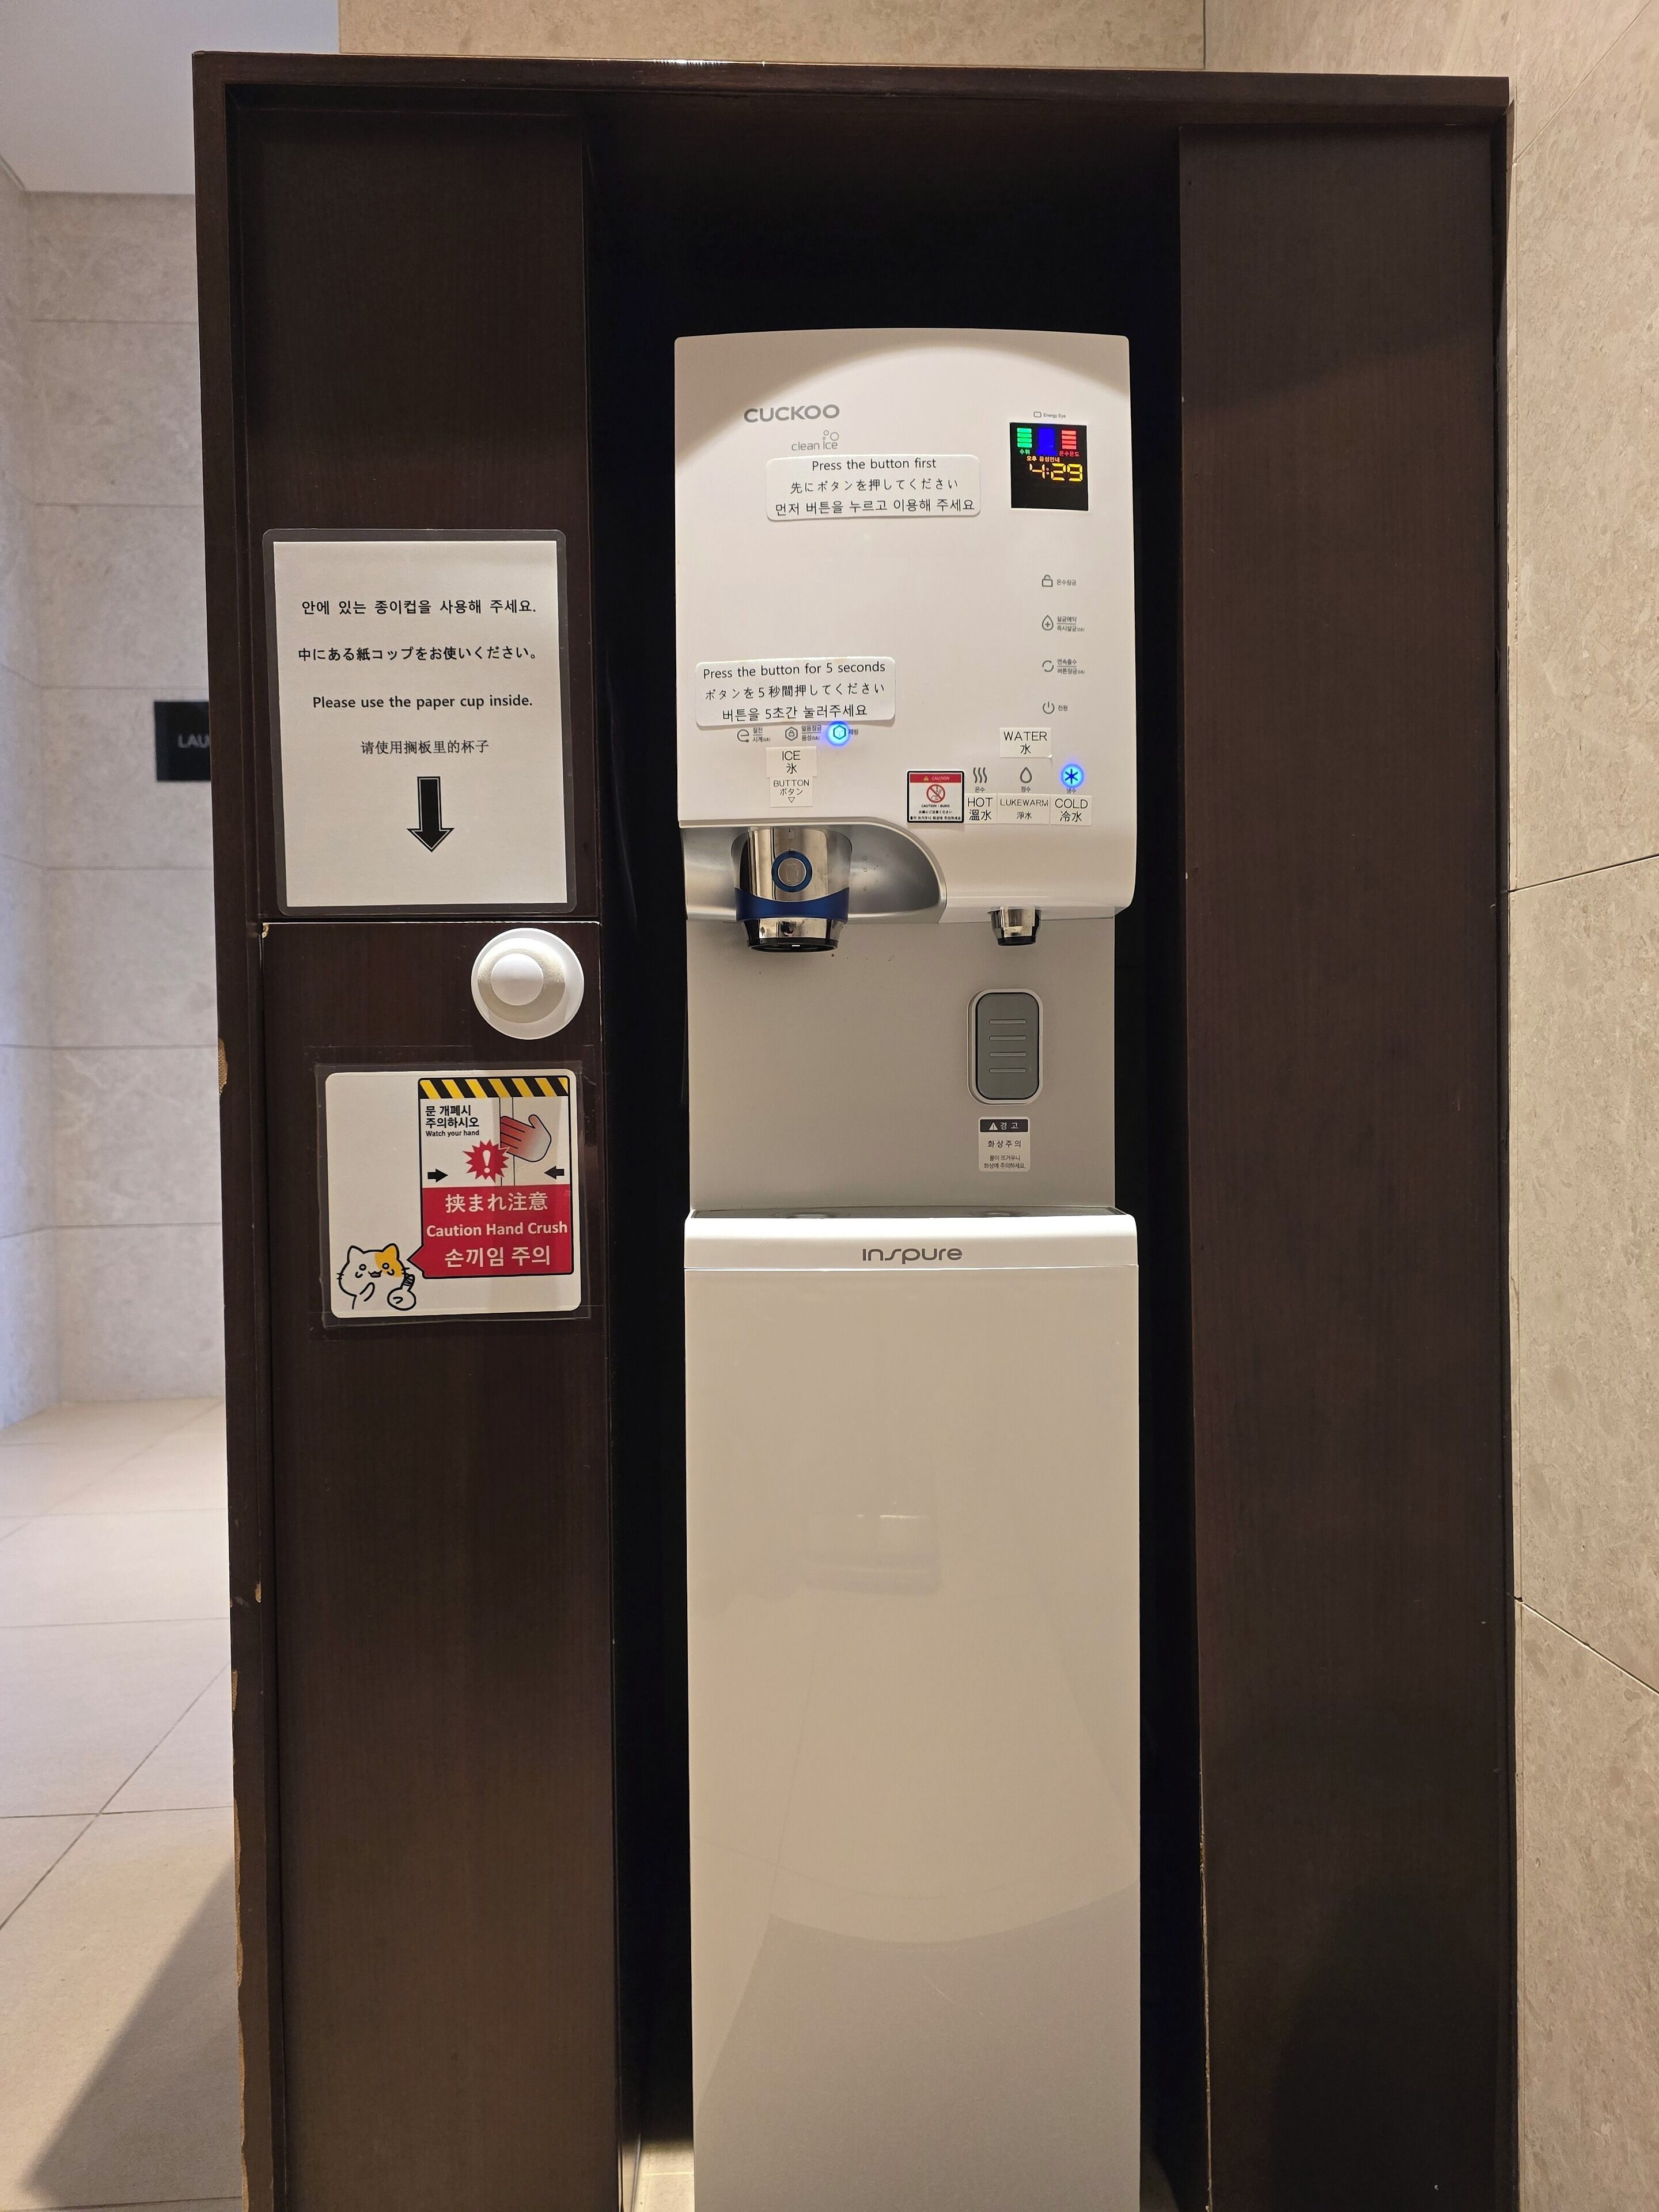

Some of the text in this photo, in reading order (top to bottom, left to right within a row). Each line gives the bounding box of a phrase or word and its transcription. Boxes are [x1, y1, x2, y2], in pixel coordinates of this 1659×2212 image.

[744, 404, 840, 423] CUCKOO
[791, 441, 820, 451] clean
[812, 457, 936, 471] Press the button first
[1029, 463, 1083, 482] 4:29
[790, 478, 958, 494] 先にボタンを押してください
[776, 499, 975, 516] 먼저 버튼을 누르고 이용해 주세요
[302, 599, 536, 615] 안에 있는 종이컵을 사용해 주세요.
[298, 646, 537, 661] 中にある紙コップをお使いください。
[703, 661, 885, 679] Press the button for 5 seconds
[706, 683, 885, 700] ボタンを5秒間押してください
[313, 695, 533, 710] Please use the paper cup inside.
[723, 704, 867, 722] 버튼을 5초간 눌러주세요
[1003, 732, 1047, 741] WATER
[361, 740, 489, 755] 请使用搁板里的杯子
[1020, 744, 1031, 755] 水
[782, 751, 801, 761] ICE
[786, 763, 797, 774] 氷
[968, 797, 993, 807] HOT
[1055, 798, 1088, 809] COLD
[1060, 811, 1082, 822] 冷水
[426, 1104, 471, 1116] 문 개폐시
[426, 1118, 479, 1128] 주의하시오
[445, 1192, 548, 1214] 挟まれ注意
[427, 1222, 568, 1237] Caution Hand Crush
[445, 1246, 550, 1267] 손끼임 주의
